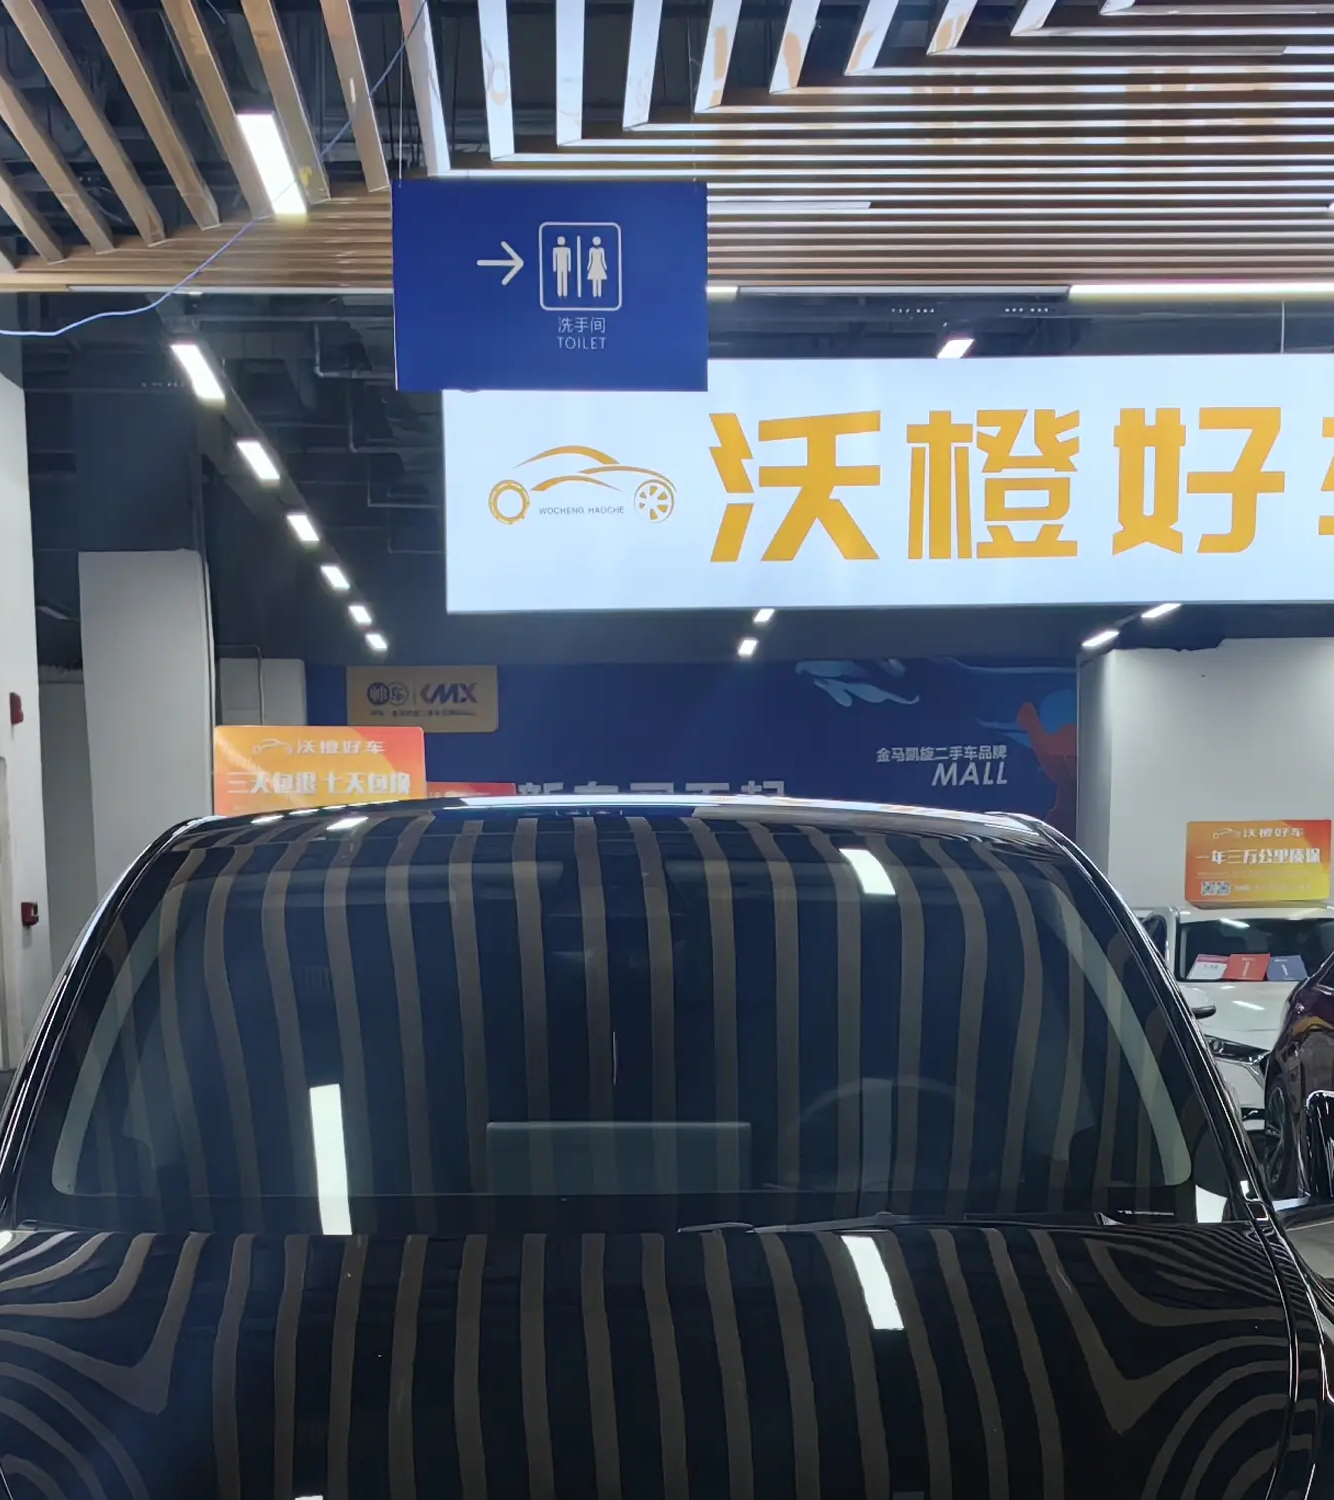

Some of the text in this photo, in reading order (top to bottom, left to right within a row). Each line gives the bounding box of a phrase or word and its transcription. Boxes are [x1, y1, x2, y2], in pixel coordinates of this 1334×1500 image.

[557, 316, 606, 333] 洗手间
[557, 336, 607, 349] TOILET
[420, 682, 478, 704] CMX
[296, 739, 386, 754] 沃橙好车
[227, 771, 411, 795] 三天包退 七天包换
[931, 761, 1008, 786] MALL
